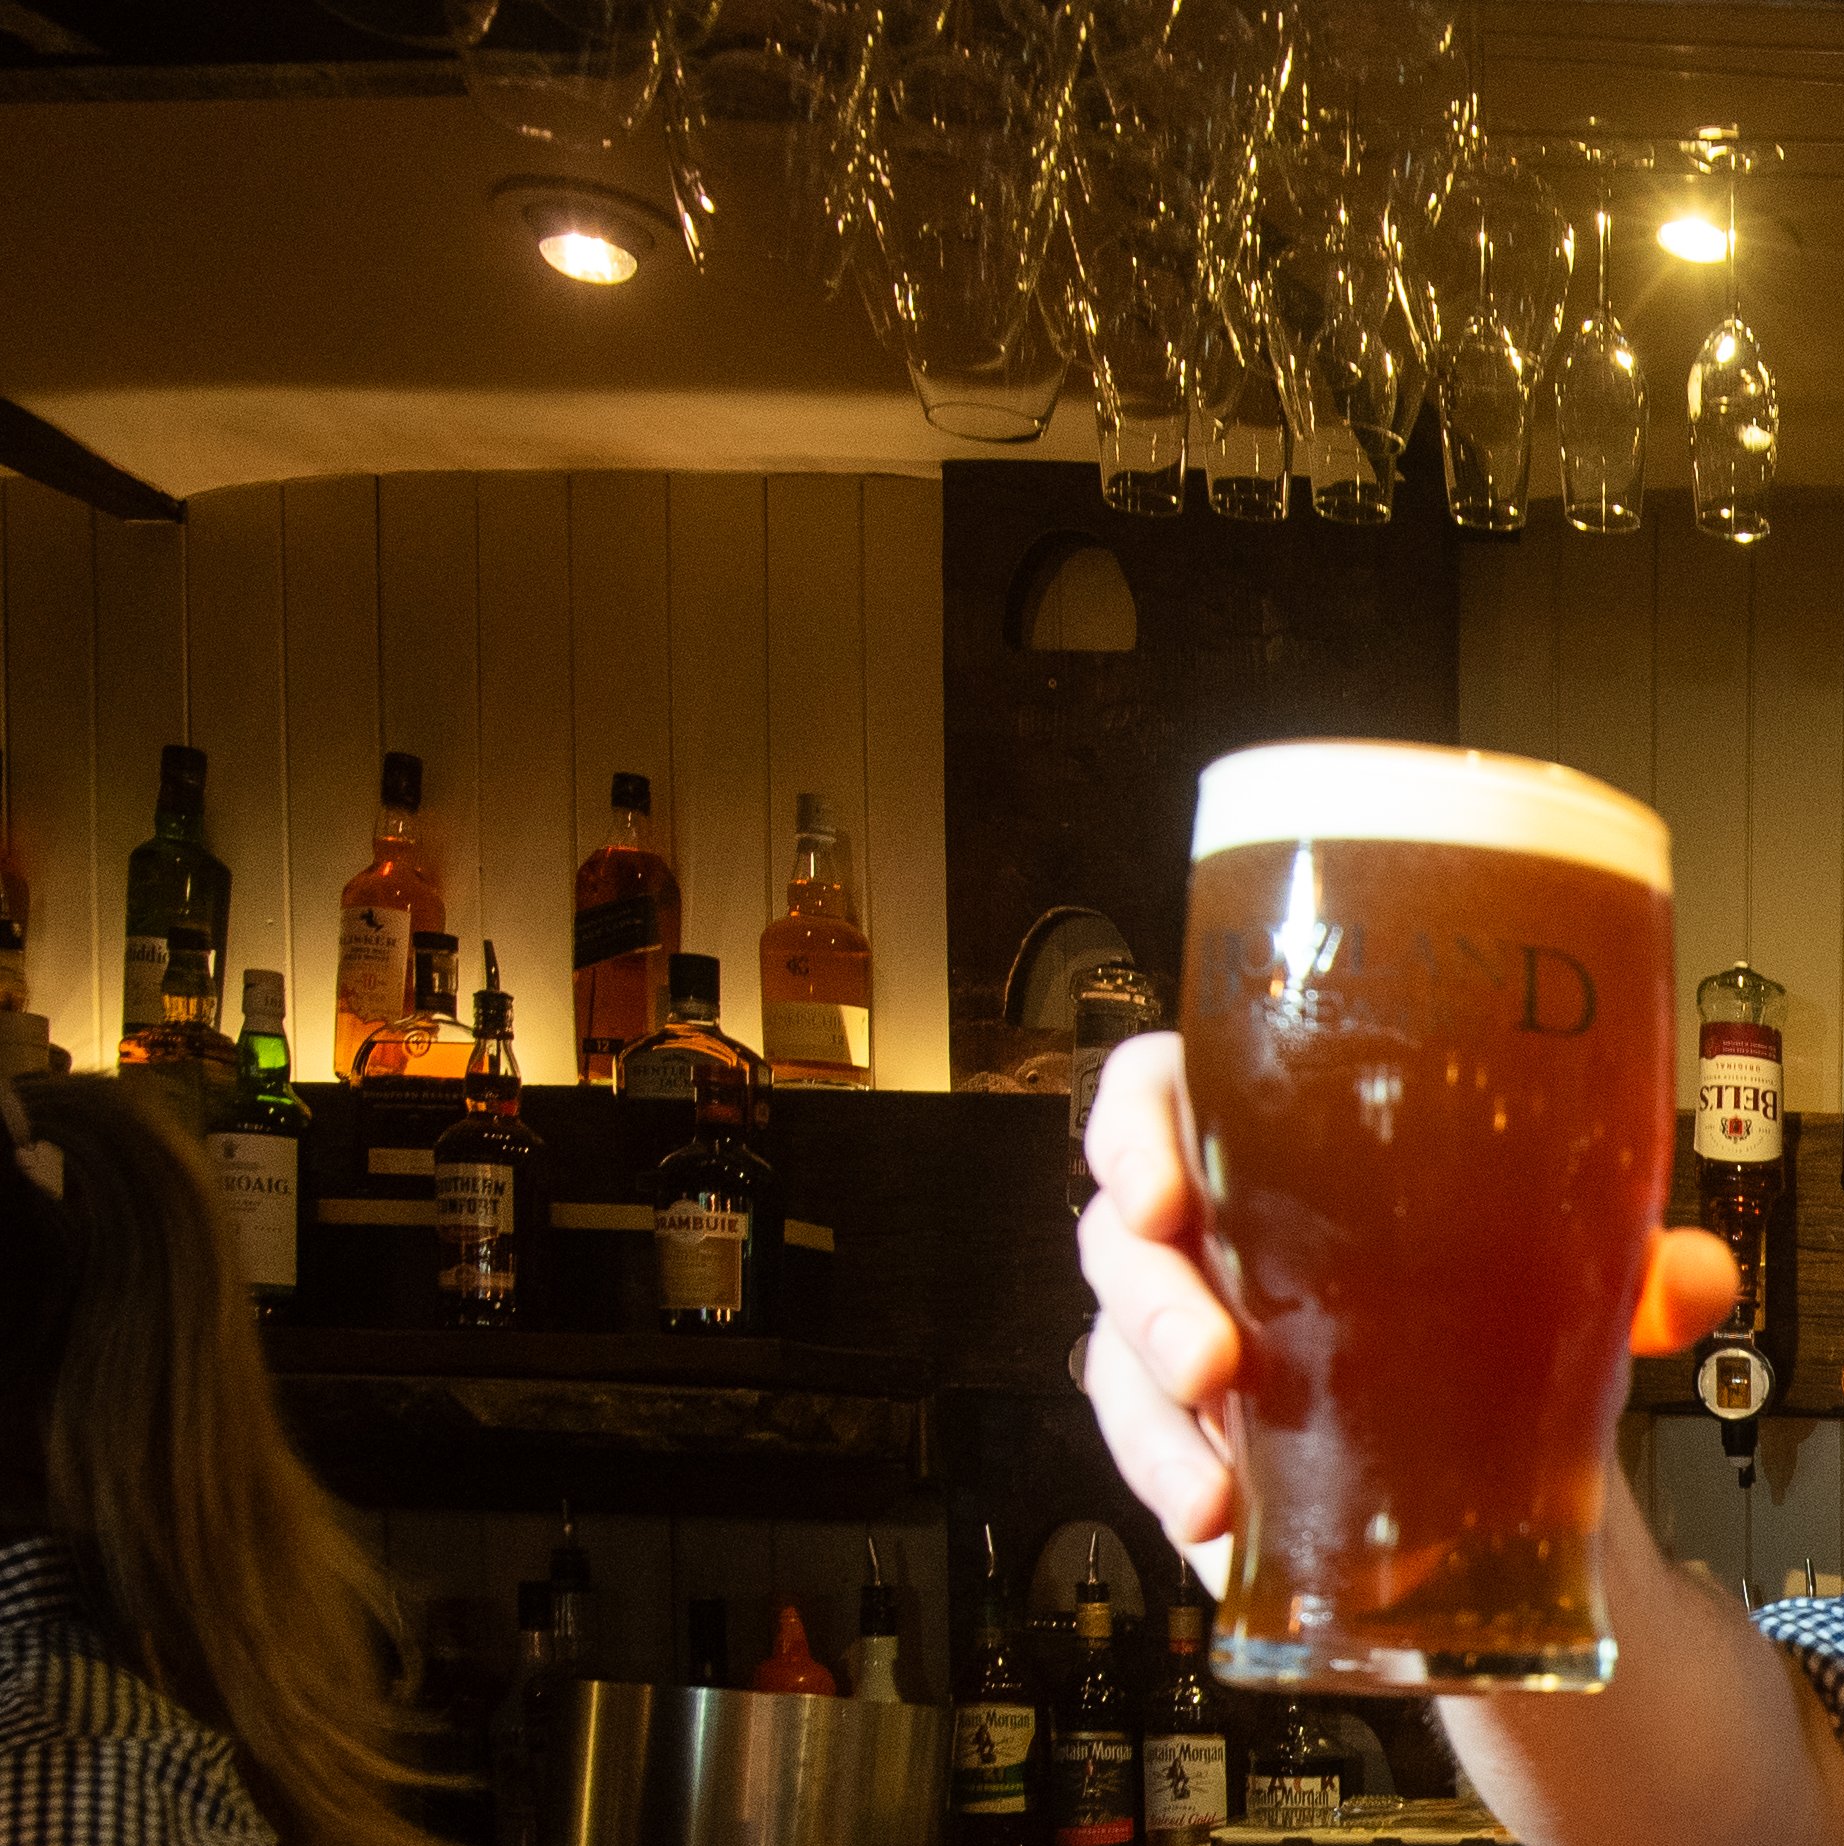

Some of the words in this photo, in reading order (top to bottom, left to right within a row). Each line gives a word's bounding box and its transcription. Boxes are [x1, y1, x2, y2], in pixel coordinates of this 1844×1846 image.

[1714, 1062, 1761, 1072] ORIGINAL
[1698, 1084, 1779, 1123] BELL'S
[985, 1709, 1031, 1729] Morgan
[1179, 1742, 1224, 1764] Morgan
[1281, 1787, 1330, 1809] Morgan
